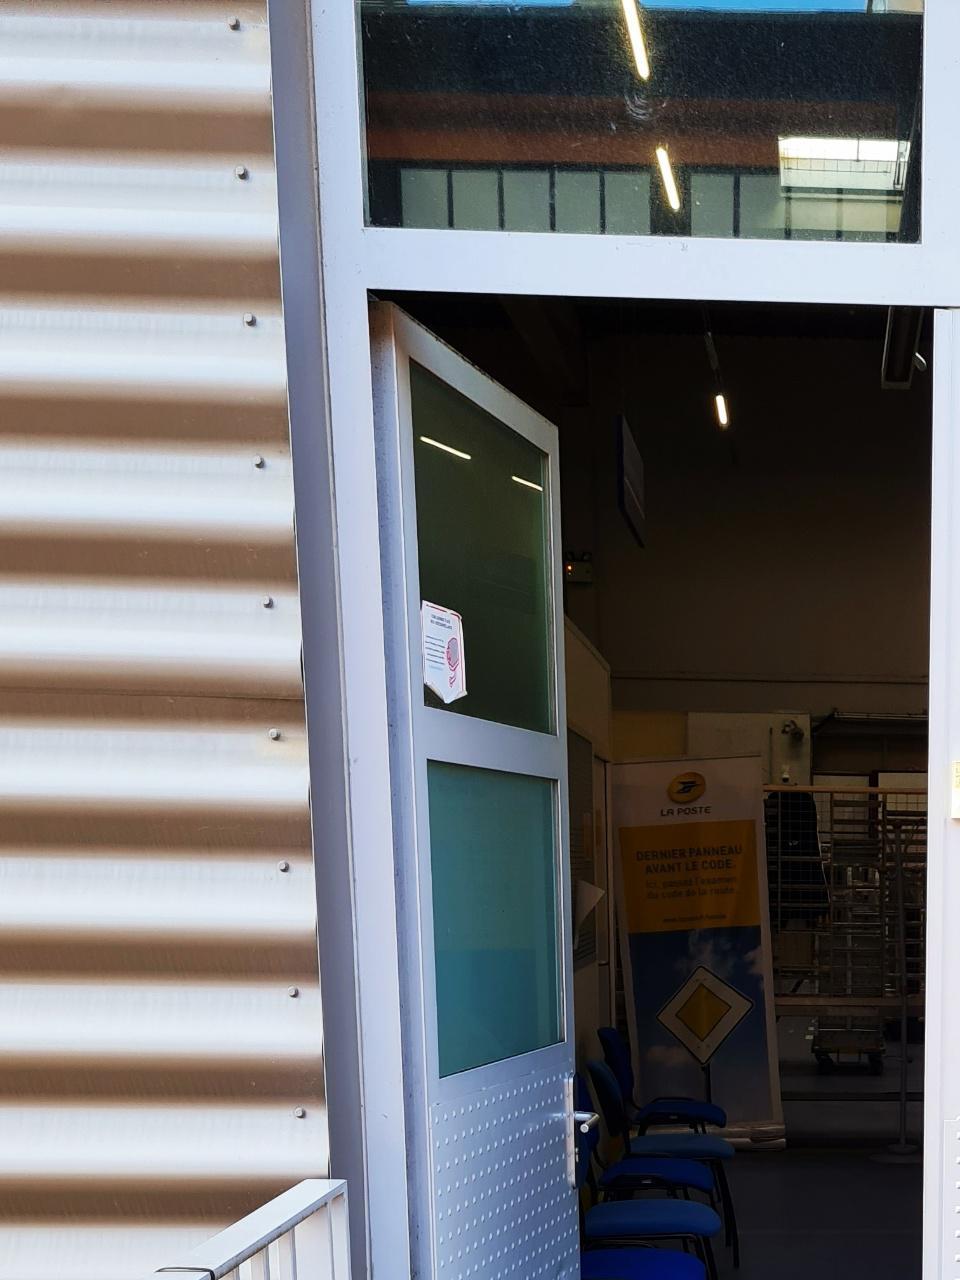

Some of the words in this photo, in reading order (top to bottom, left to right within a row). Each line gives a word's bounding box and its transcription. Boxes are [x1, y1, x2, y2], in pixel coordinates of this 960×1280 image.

[660, 808, 675, 817] LA
[677, 806, 712, 816] POSTE
[636, 848, 686, 861] DERNIER
[688, 845, 742, 858] PANNEAU
[645, 863, 682, 874] AVANT
[685, 861, 697, 872] LE
